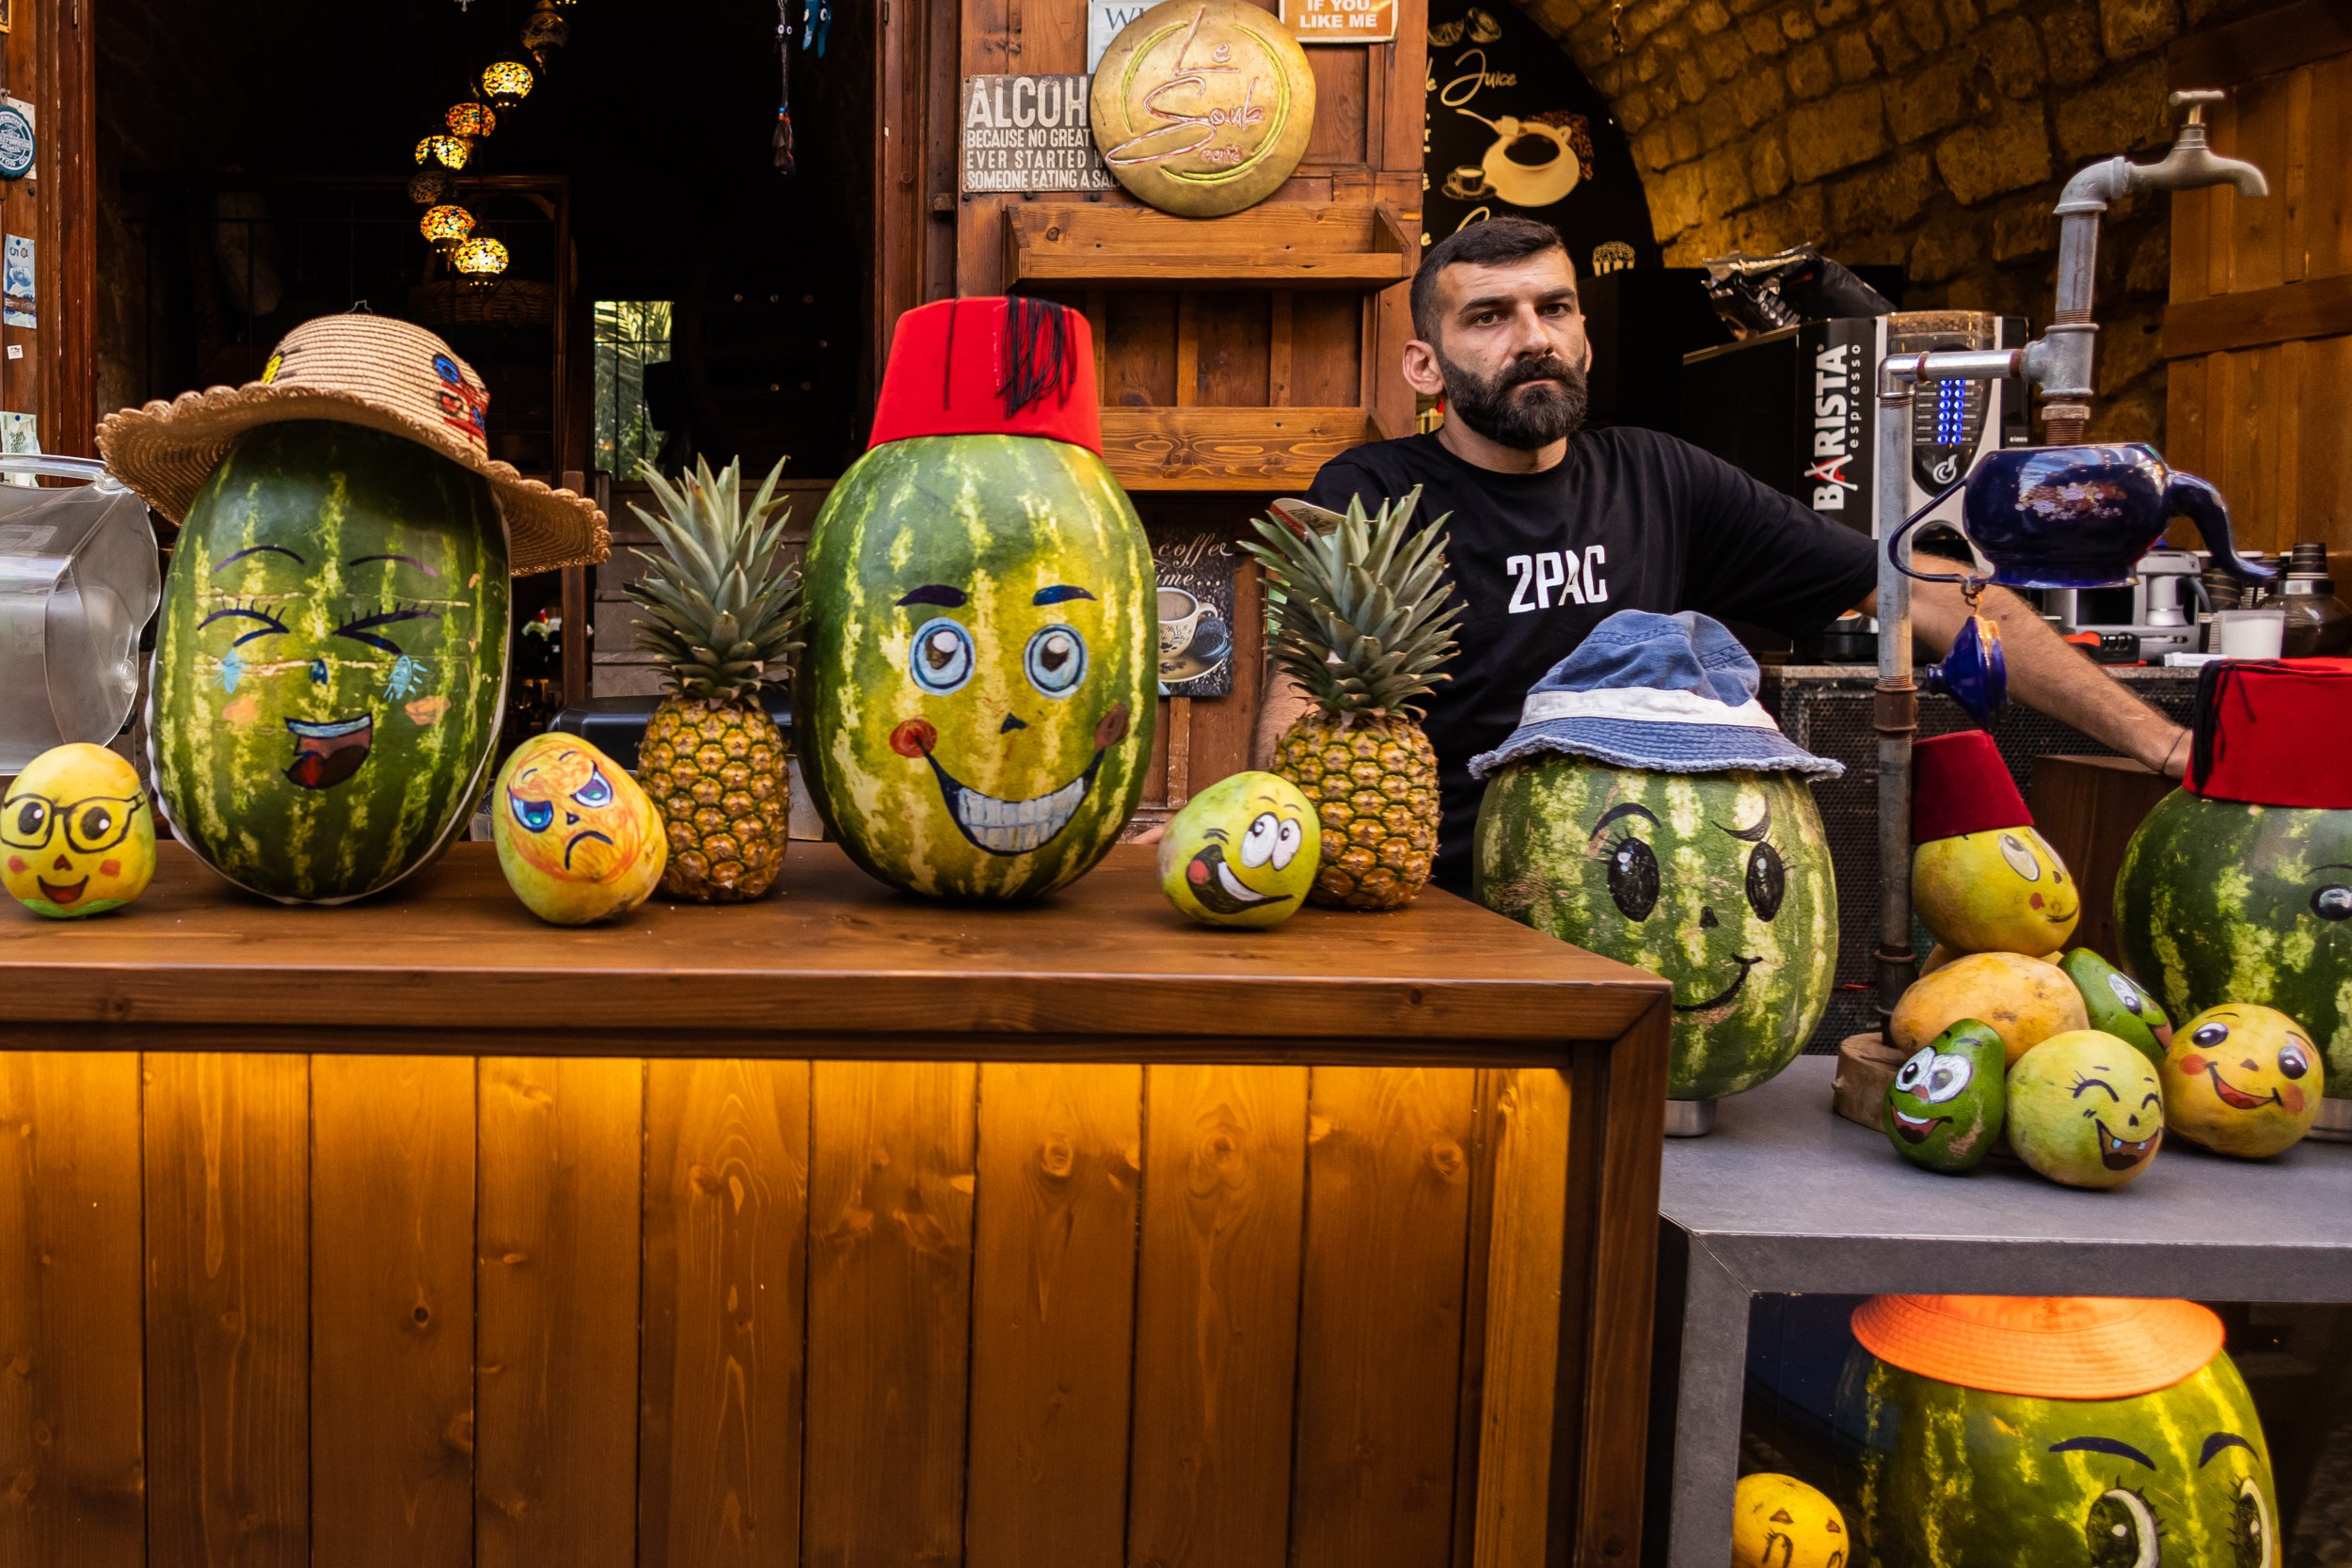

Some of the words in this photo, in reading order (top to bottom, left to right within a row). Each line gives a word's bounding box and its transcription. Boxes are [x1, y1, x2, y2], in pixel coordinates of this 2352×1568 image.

[1299, 14, 1343, 28] LIKE
[1348, 14, 1377, 28] ME
[1307, 0, 1324, 11] IF
[1330, 0, 1370, 11] YOU
[1170, 5, 1241, 79] Le
[966, 76, 1088, 128] ALCOH
[1440, 48, 1518, 106] Juice
[966, 128, 1025, 149] BECAUSE
[1028, 128, 1047, 148] NO
[1050, 128, 1091, 148] GREAT
[966, 150, 1008, 169] EVER
[1014, 150, 1087, 169] STARTED
[966, 169, 1028, 189] SOMEONE
[1032, 169, 1077, 188] EATING
[1080, 169, 1090, 188] A
[1092, 169, 1120, 188] SAL
[1850, 344, 1863, 449] espresso
[1805, 344, 1857, 511] BARISTA
[1506, 545, 1608, 614] 2PAC
